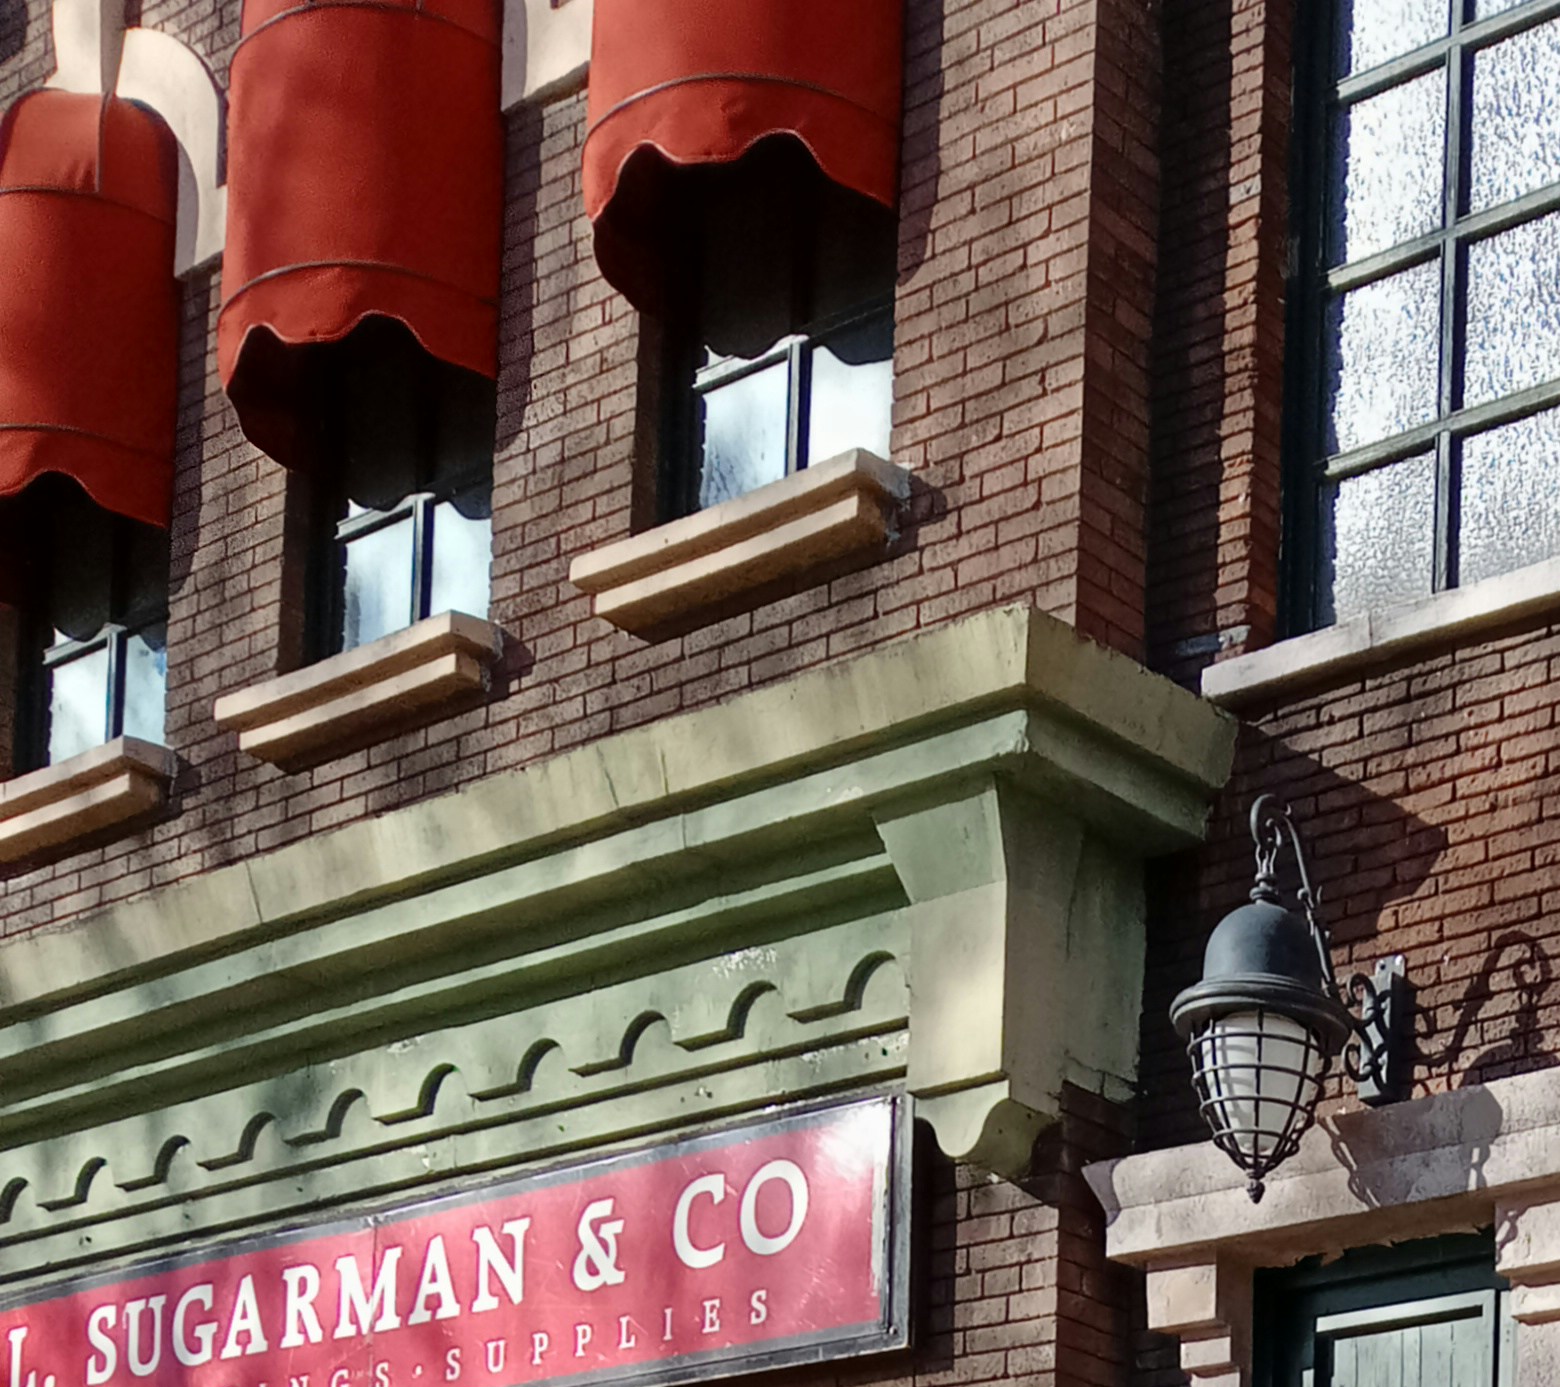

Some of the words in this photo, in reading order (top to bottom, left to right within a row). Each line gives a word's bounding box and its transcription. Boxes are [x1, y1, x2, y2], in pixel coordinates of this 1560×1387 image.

[86, 1217, 530, 1386] SUGARMAN
[572, 1197, 626, 1292] &
[672, 1158, 810, 1269] CO
[445, 1288, 768, 1381] SUPPLIES
